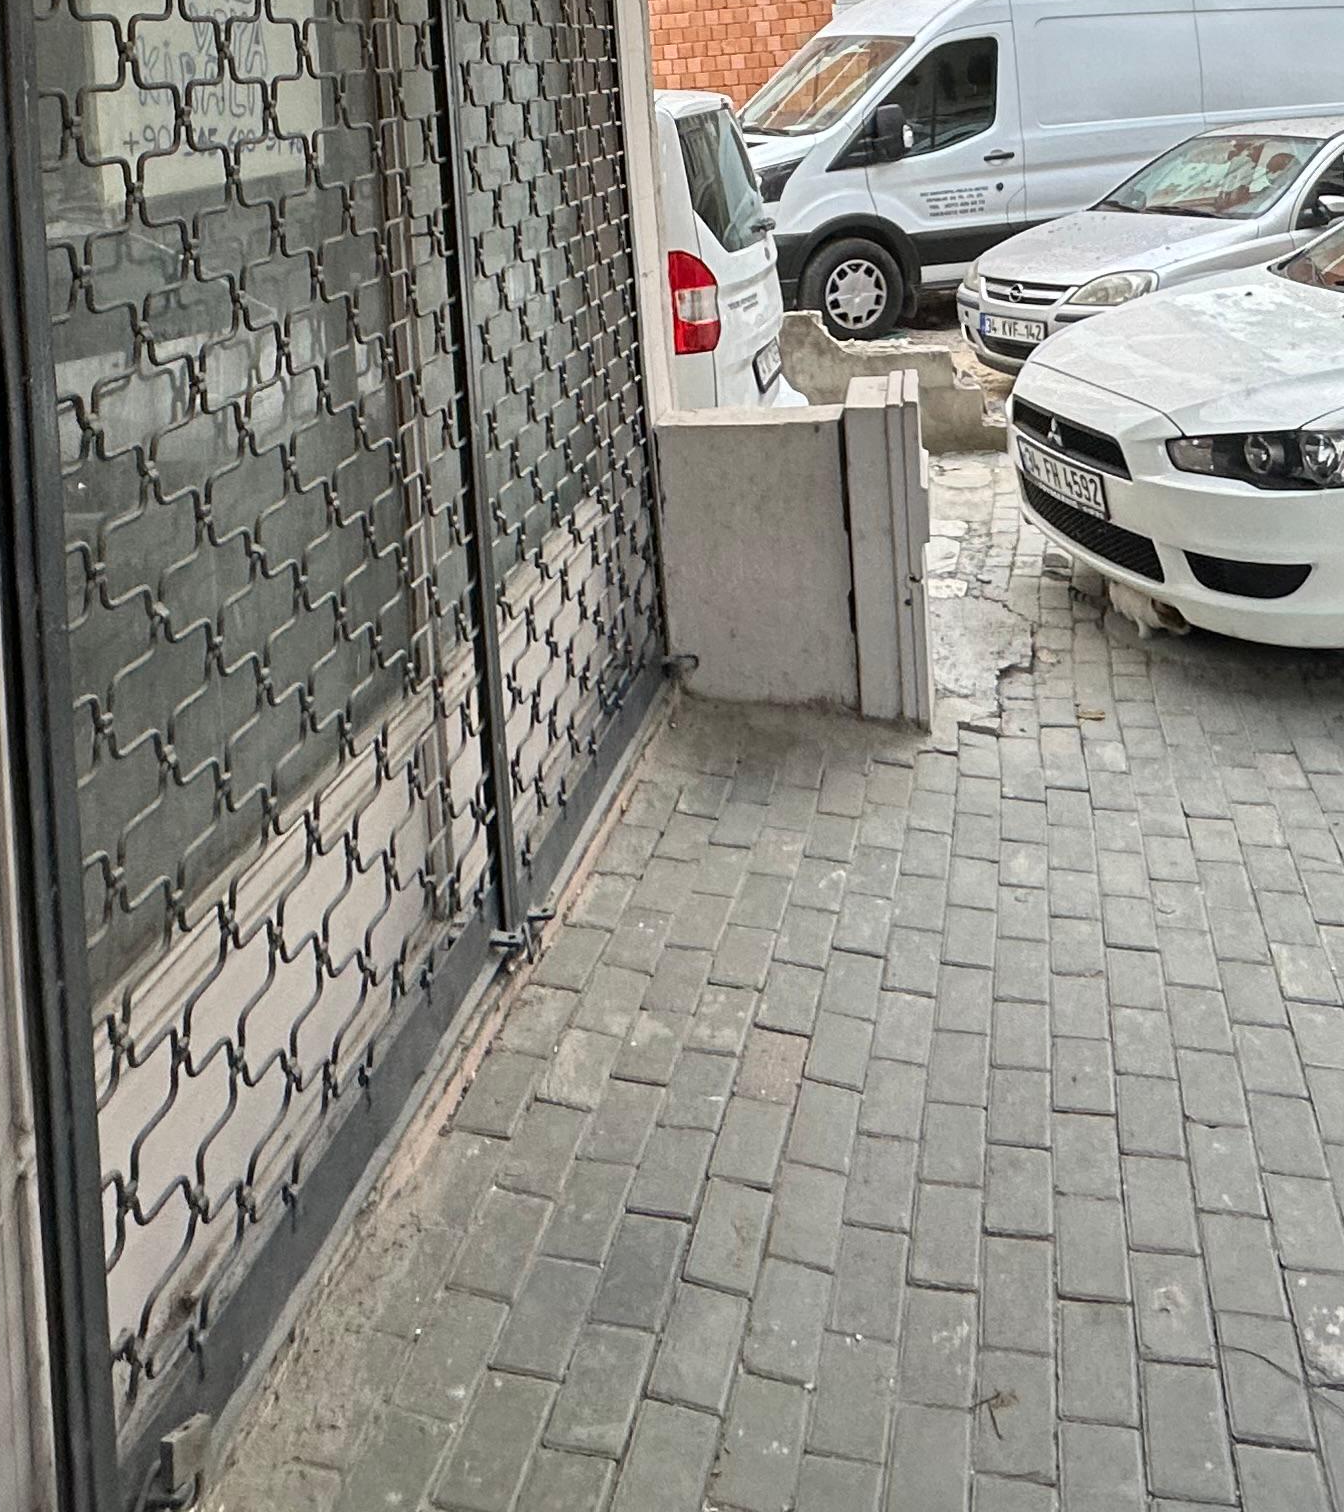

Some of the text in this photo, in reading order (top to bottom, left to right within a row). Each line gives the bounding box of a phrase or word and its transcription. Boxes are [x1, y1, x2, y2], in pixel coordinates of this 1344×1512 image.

[985, 317, 997, 334] 34
[1024, 324, 1042, 341] 142
[1023, 446, 1040, 476] 34
[1063, 466, 1102, 507] 4592
